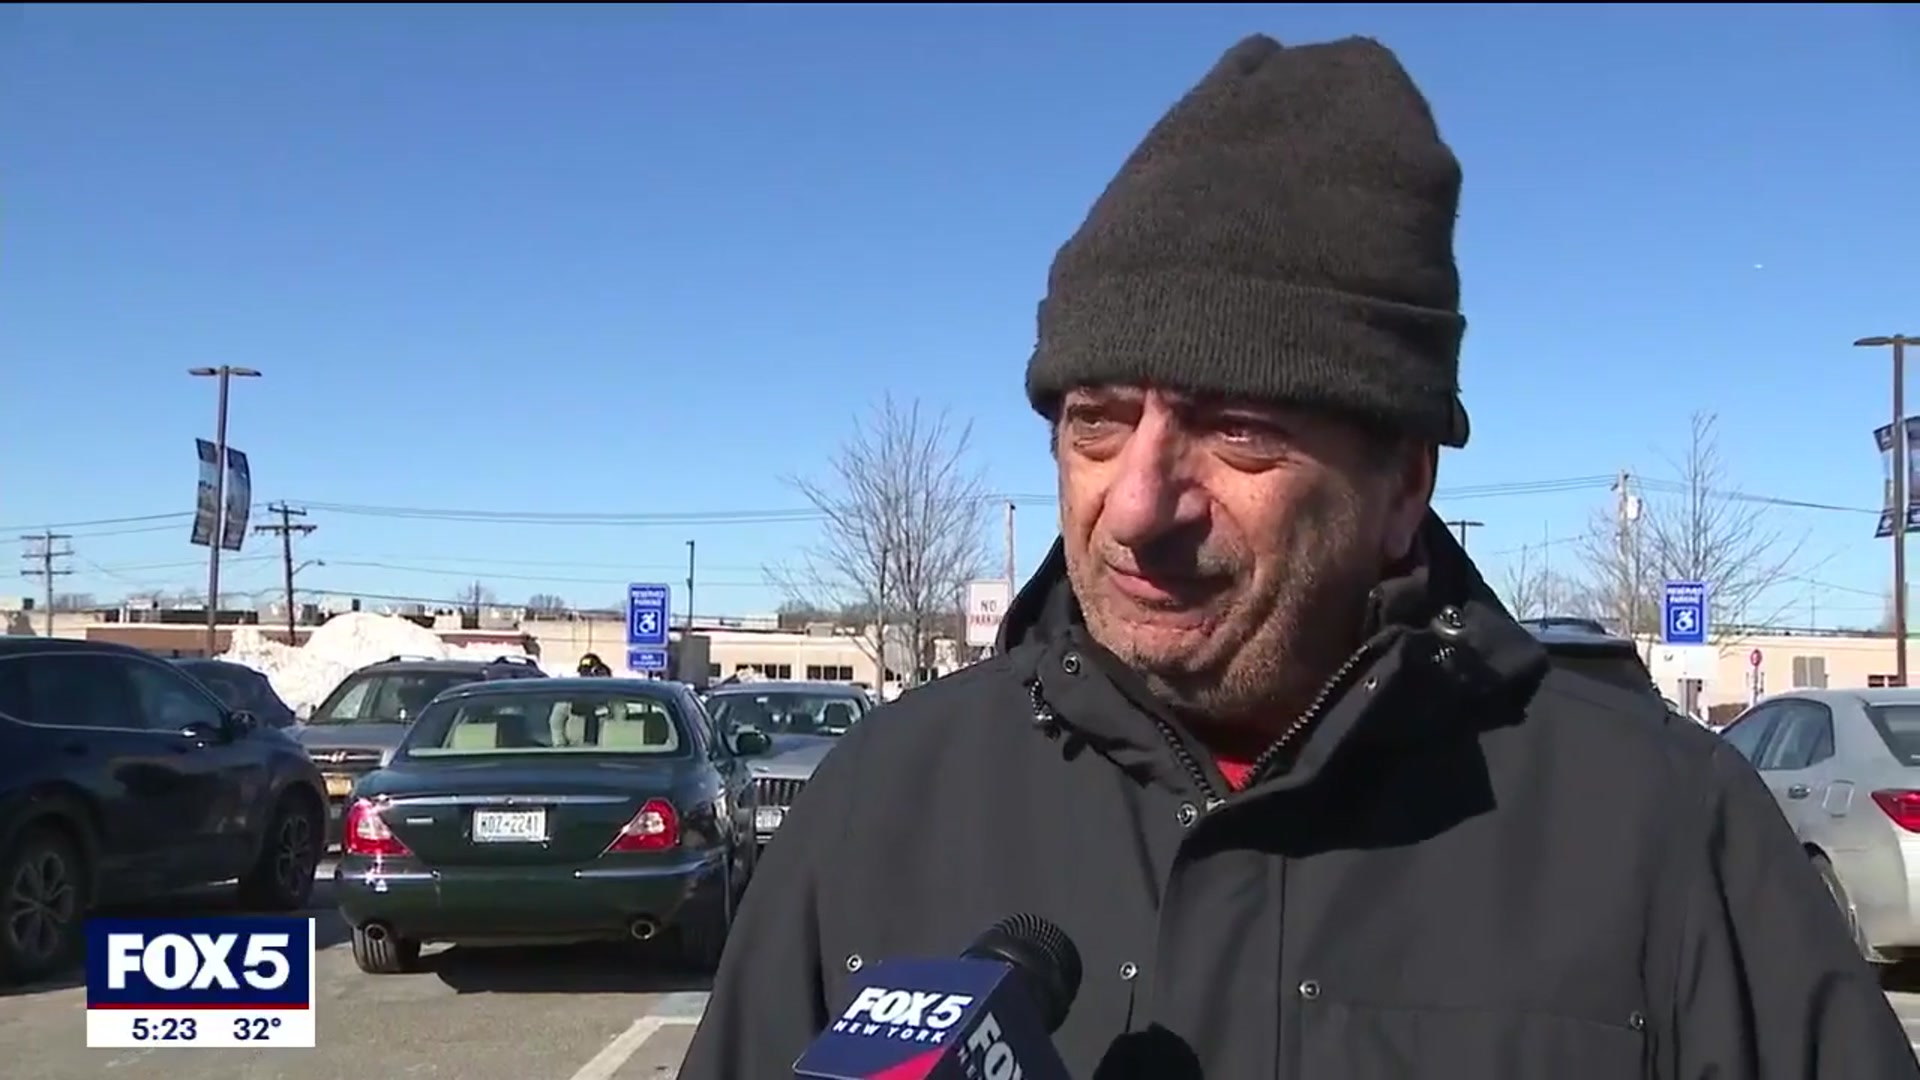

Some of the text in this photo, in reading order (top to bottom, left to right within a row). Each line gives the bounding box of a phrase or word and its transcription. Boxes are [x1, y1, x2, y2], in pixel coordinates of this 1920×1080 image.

[980, 600, 997, 612] NO
[832, 1019, 949, 1043] NEW YORK
